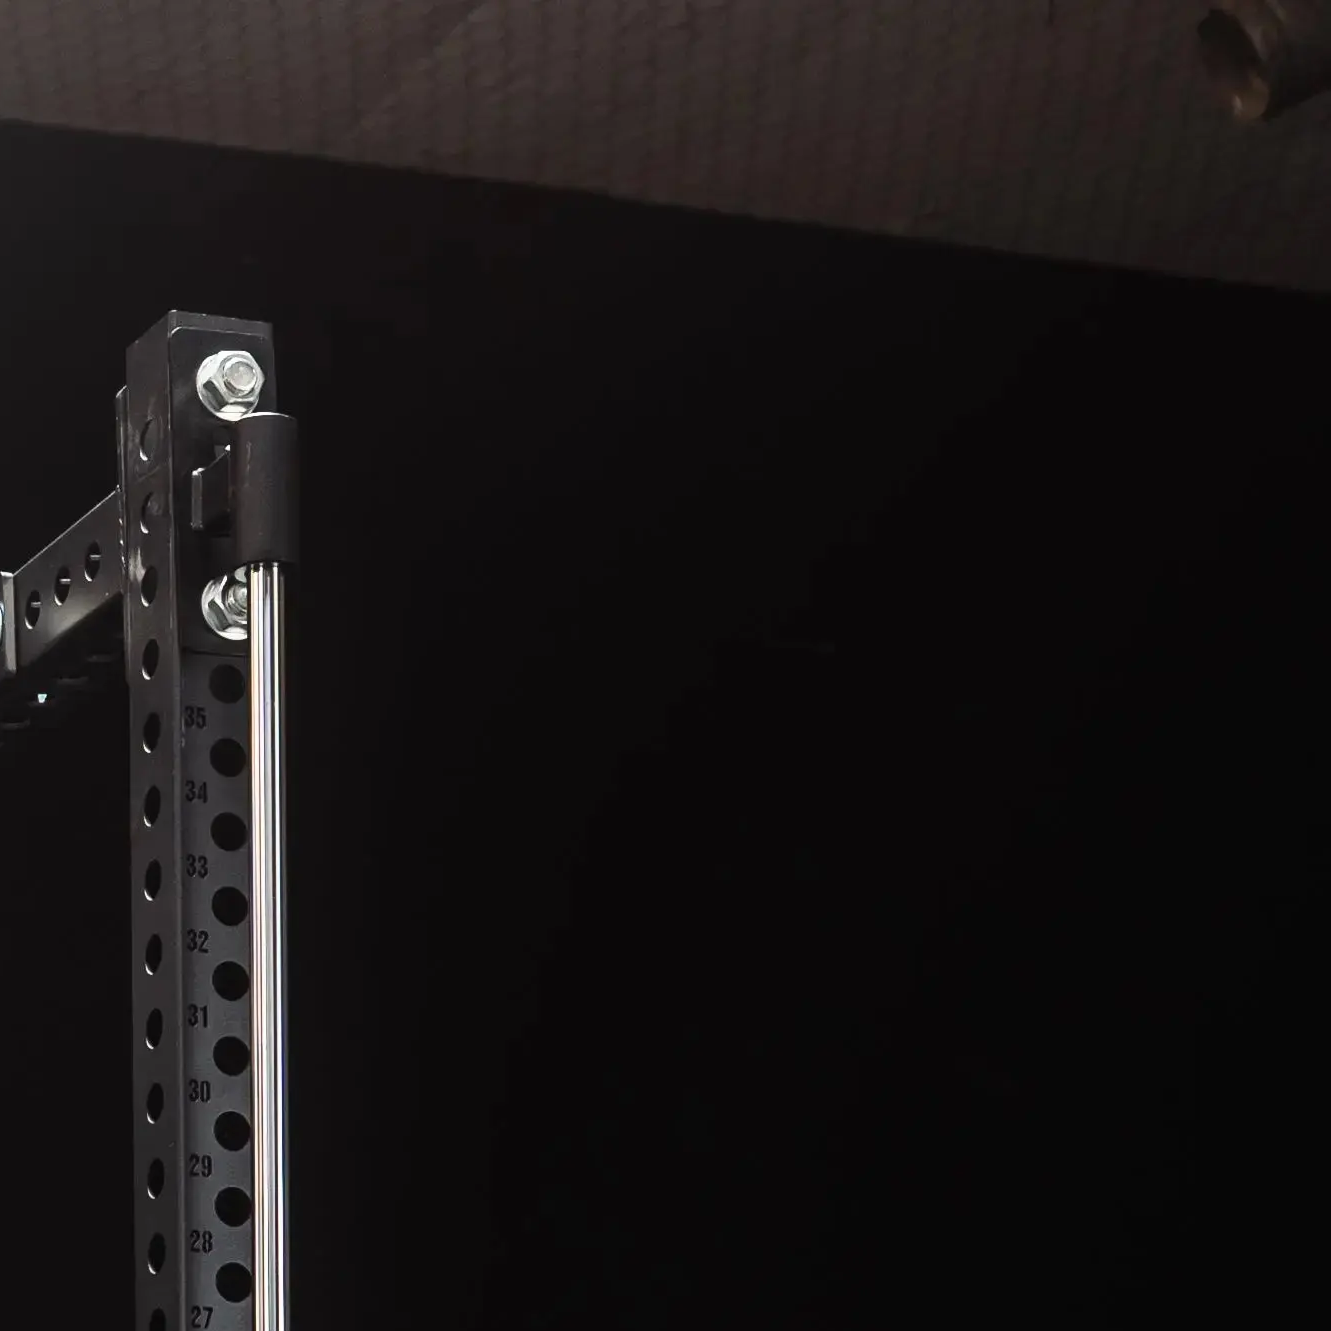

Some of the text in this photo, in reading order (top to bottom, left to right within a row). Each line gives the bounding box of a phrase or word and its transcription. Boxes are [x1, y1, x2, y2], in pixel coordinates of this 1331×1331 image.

[184, 705, 207, 730] 35
[185, 780, 209, 804] 34
[186, 853, 209, 880] 33
[187, 928, 209, 954] 32
[188, 1003, 208, 1029] 31
[189, 1078, 211, 1103] 30
[189, 1153, 213, 1178] 29
[189, 1229, 213, 1254] 28
[191, 1305, 214, 1330] 27
